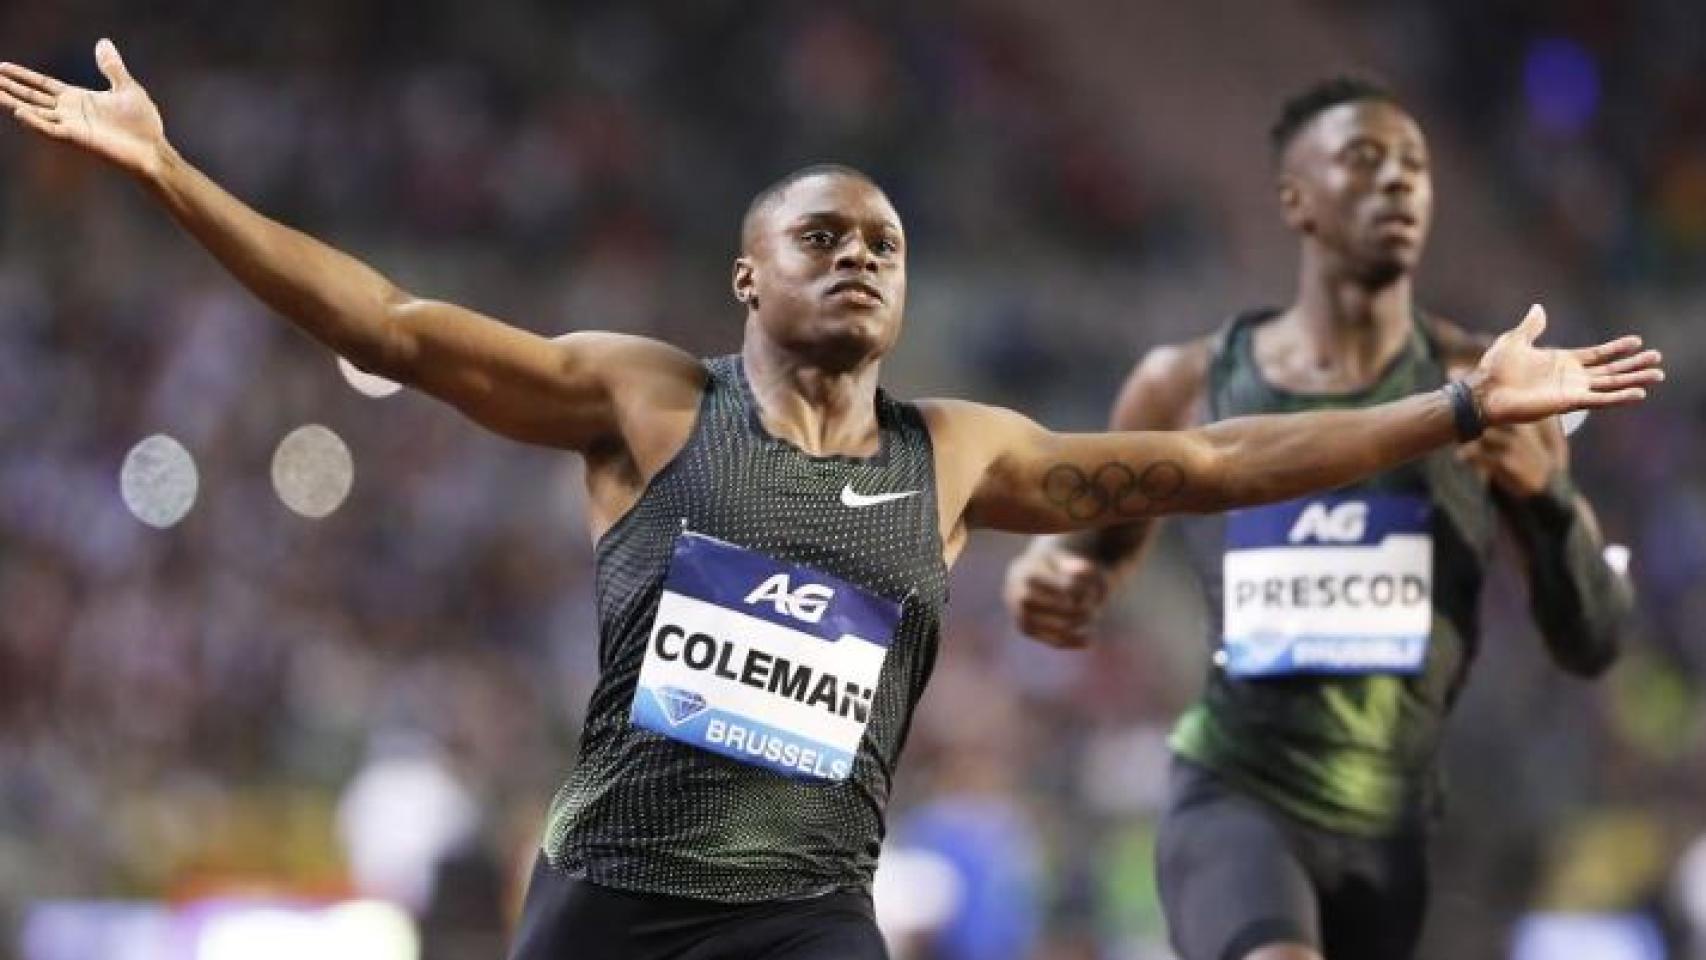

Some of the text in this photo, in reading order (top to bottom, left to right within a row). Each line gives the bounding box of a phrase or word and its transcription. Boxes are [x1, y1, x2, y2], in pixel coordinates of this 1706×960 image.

[1289, 502, 1368, 541] AG
[744, 574, 835, 622] AG
[1236, 574, 1425, 607] PRESCOD
[655, 624, 873, 723] COLEMAN
[706, 720, 849, 780] BRUSSELS
